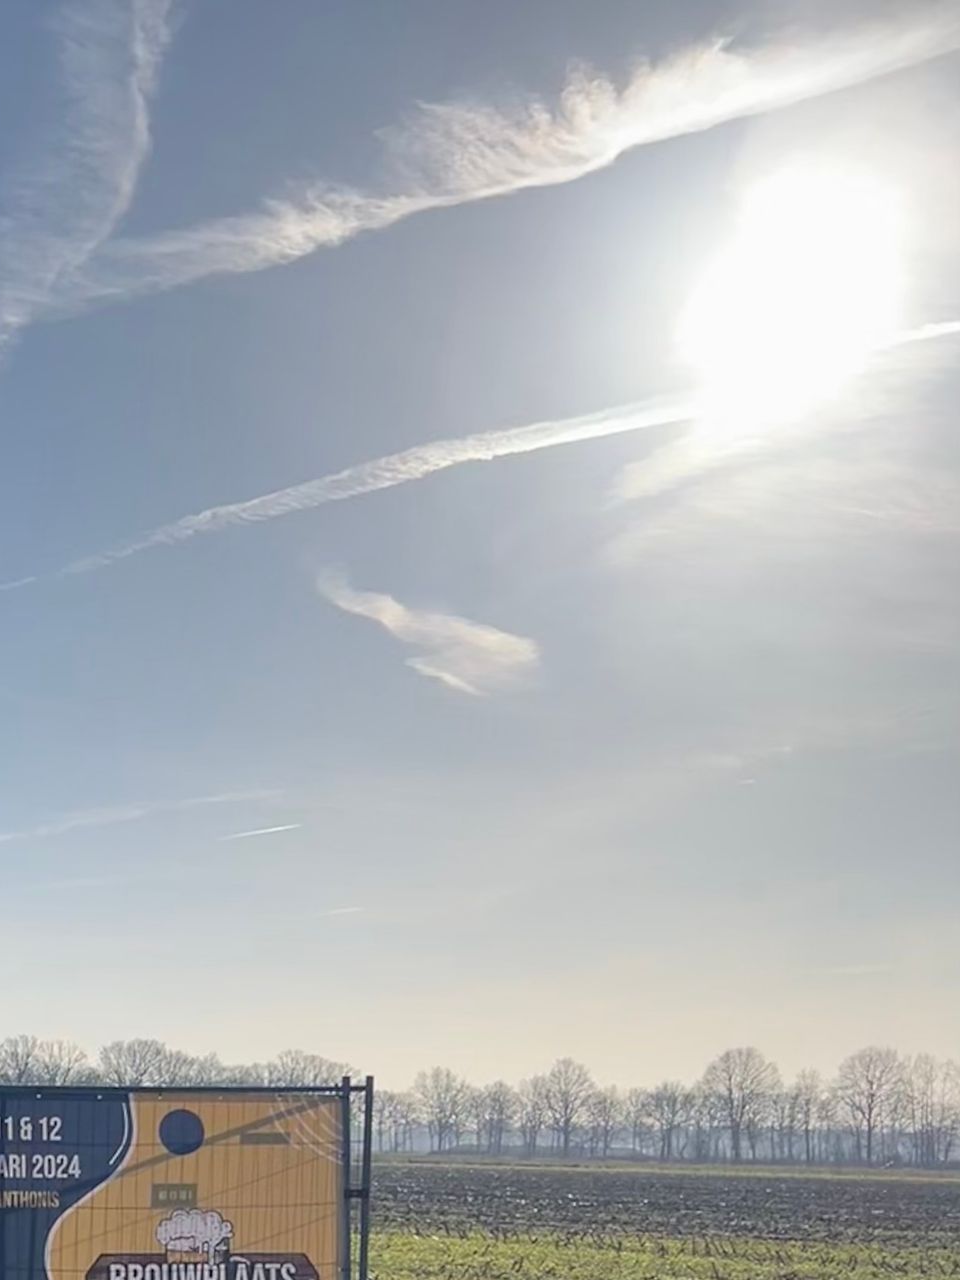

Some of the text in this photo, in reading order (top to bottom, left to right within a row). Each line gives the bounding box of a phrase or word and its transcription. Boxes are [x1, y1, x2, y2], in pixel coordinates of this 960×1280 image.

[20, 1116, 33, 1141] &
[39, 1116, 62, 1141] 12
[32, 1154, 81, 1178] 2024
